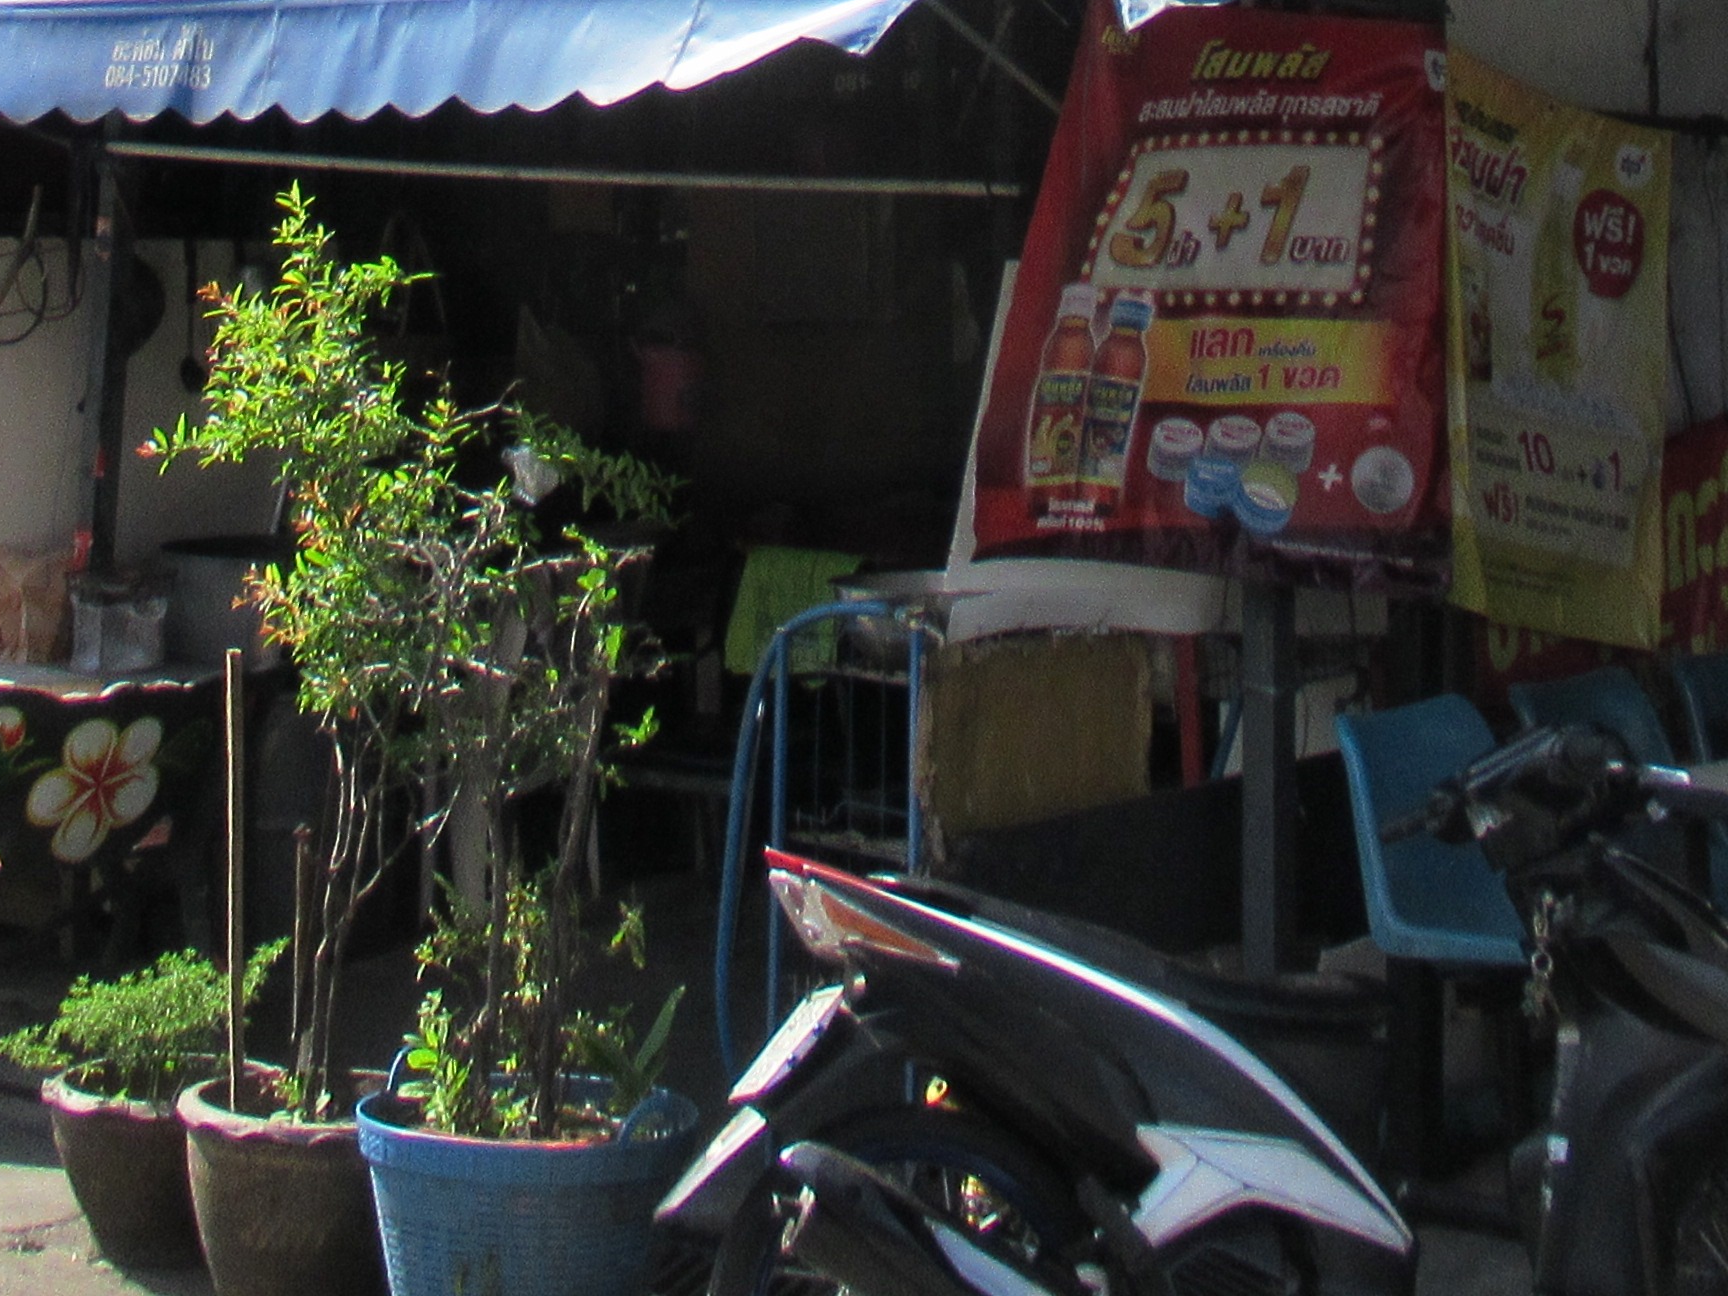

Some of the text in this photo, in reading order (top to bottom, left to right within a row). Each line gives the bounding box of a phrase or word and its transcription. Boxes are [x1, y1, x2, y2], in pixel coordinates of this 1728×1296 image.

[1109, 167, 1190, 269] 5
[1259, 164, 1312, 267] 1
[1287, 234, 1351, 265] บาท
[1188, 326, 1256, 360] แลก
[1281, 364, 1343, 392] ขวด
[1517, 429, 1556, 476] 10
